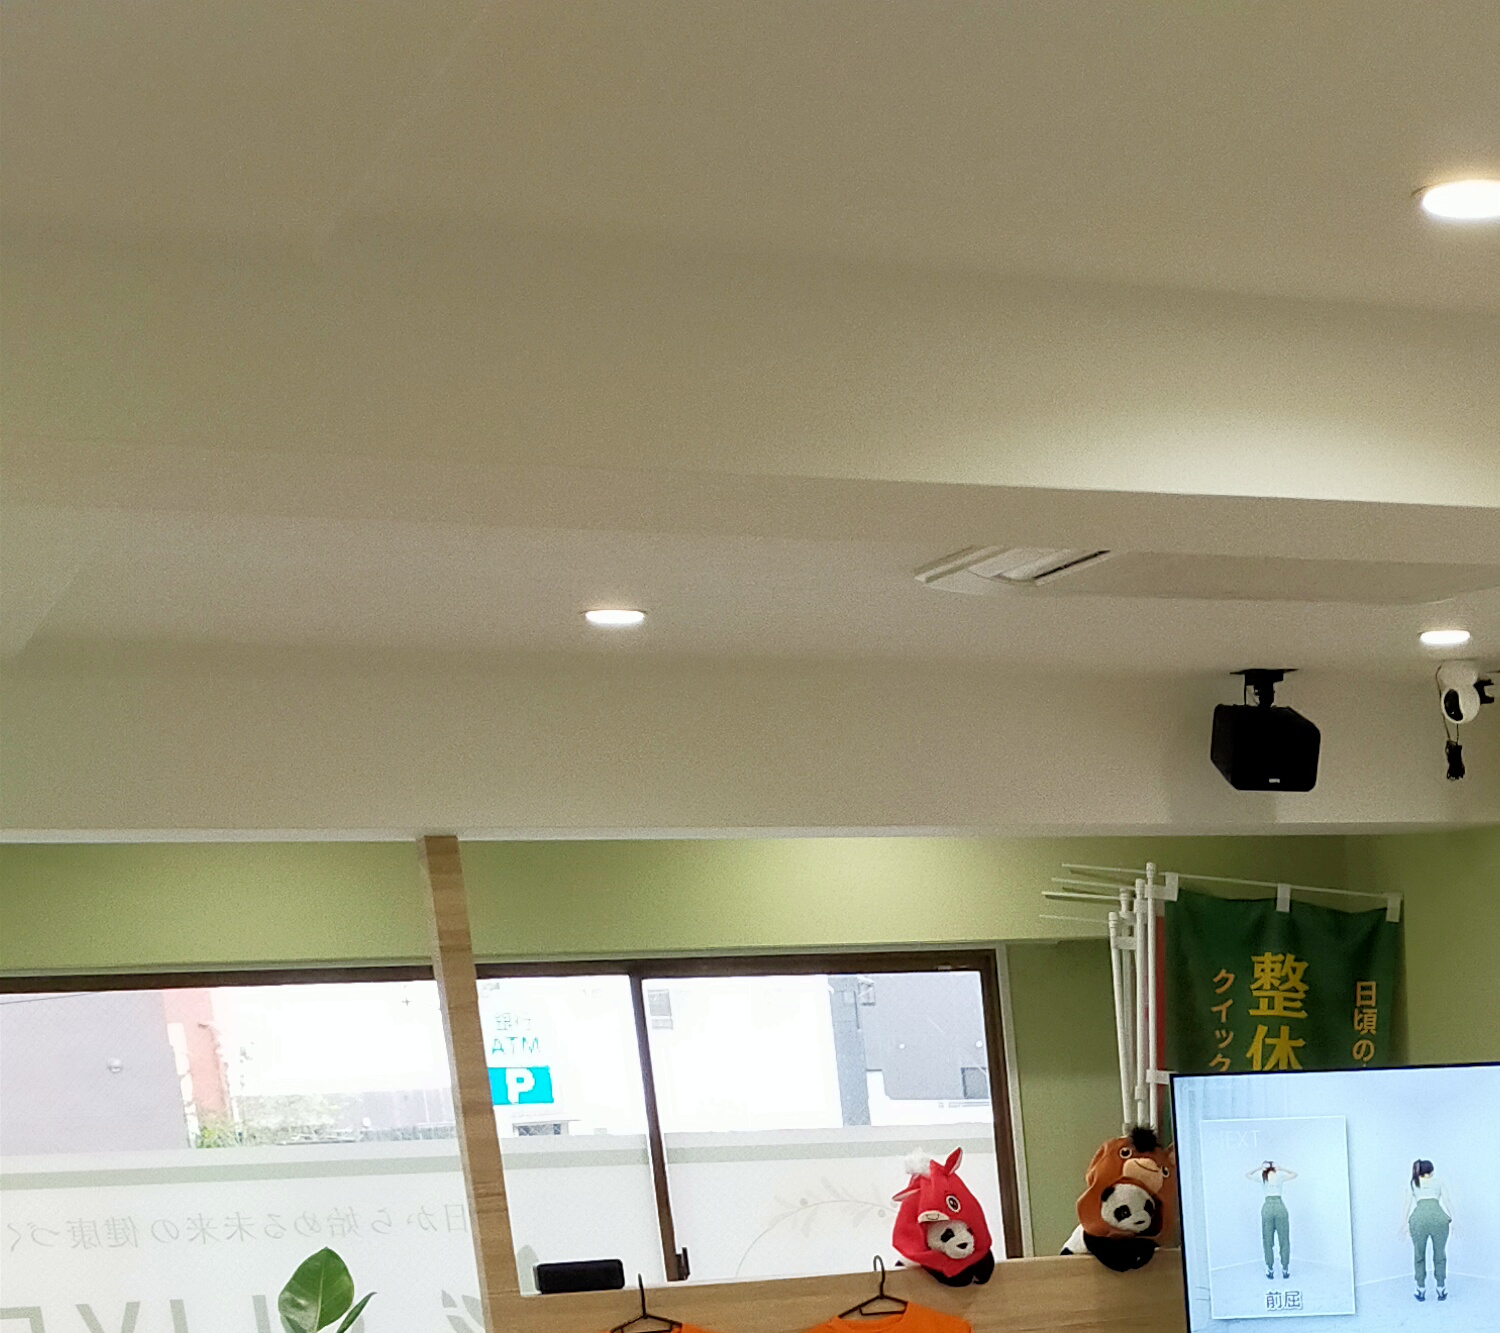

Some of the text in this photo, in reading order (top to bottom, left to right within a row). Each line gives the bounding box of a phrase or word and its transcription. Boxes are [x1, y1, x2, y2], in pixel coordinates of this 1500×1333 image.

[1208, 968, 1236, 1072] クイック
[1352, 981, 1378, 1067] 日頃の
[491, 1036, 540, 1055] ATM
[505, 1067, 536, 1104] P
[1265, 1289, 1302, 1310] 前屈
